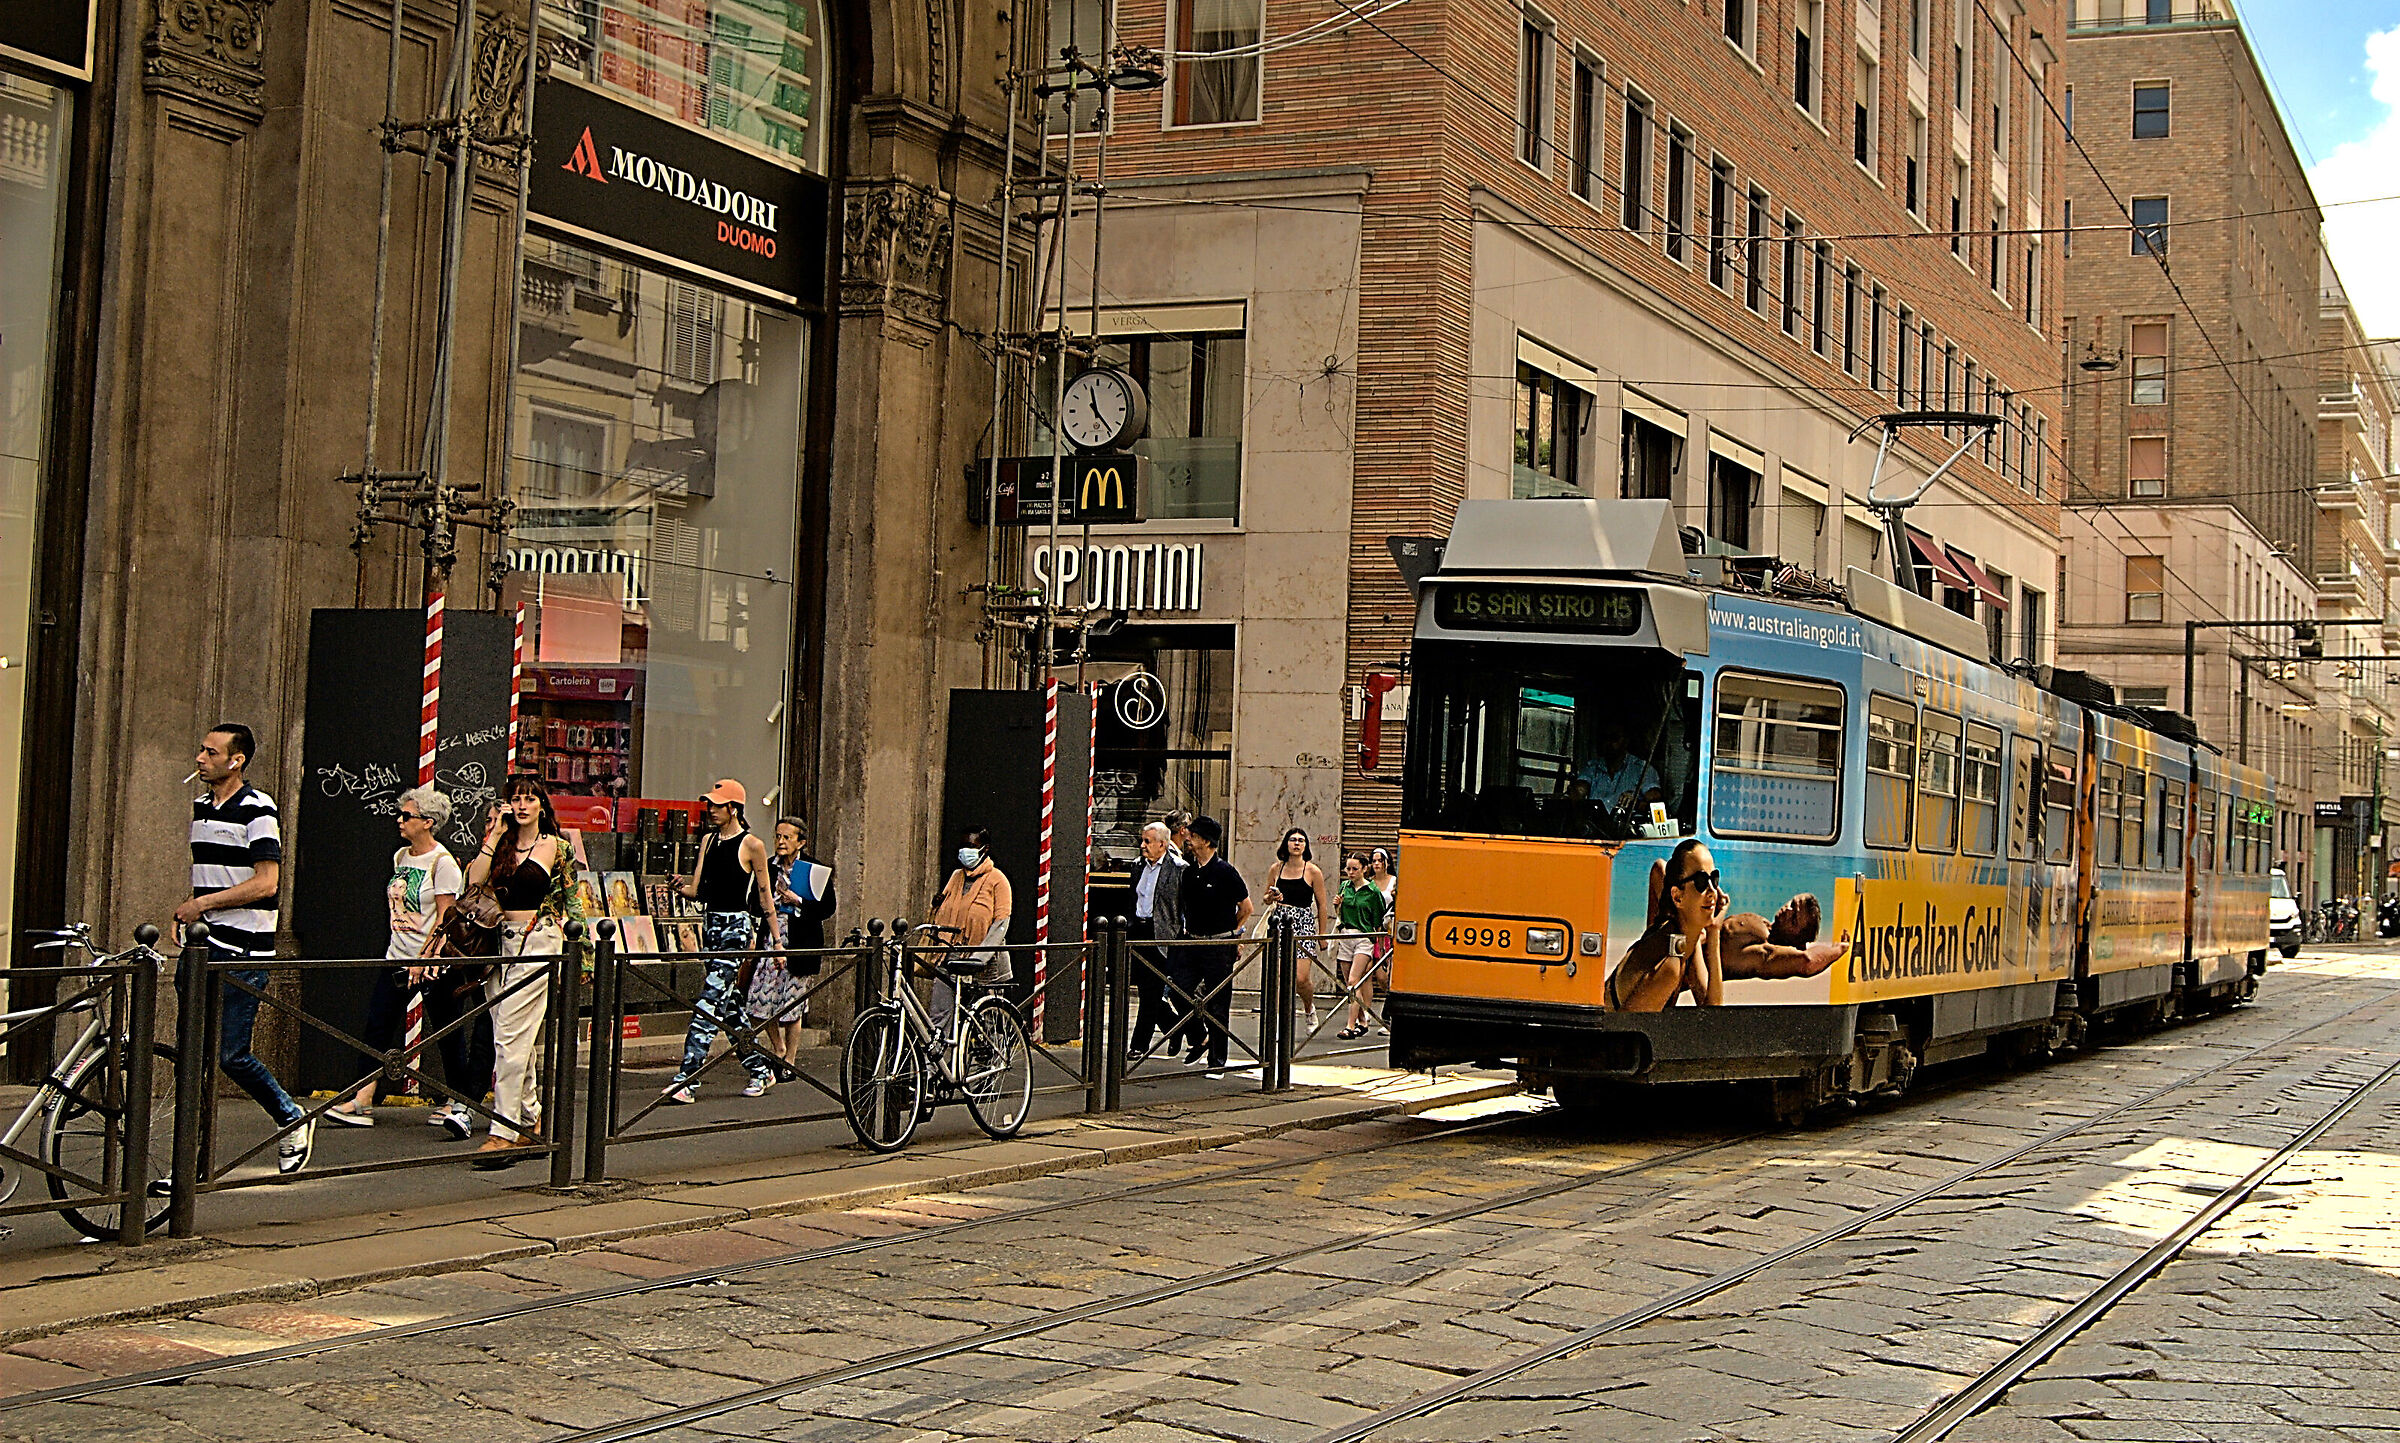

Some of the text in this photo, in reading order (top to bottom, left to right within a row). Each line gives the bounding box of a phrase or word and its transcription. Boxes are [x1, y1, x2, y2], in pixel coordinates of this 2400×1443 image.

[608, 145, 779, 233] MONDADORI
[717, 220, 777, 259] DUOMO
[1033, 543, 1201, 612] SPONTINI
[1453, 592, 1632, 619] 16 SAN SIRO M5
[1708, 608, 1861, 649] www.australiangold.it
[549, 675, 591, 686] Cartoleria
[1445, 926, 1511, 948] 4998
[1848, 893, 2002, 983] Australian Gold
